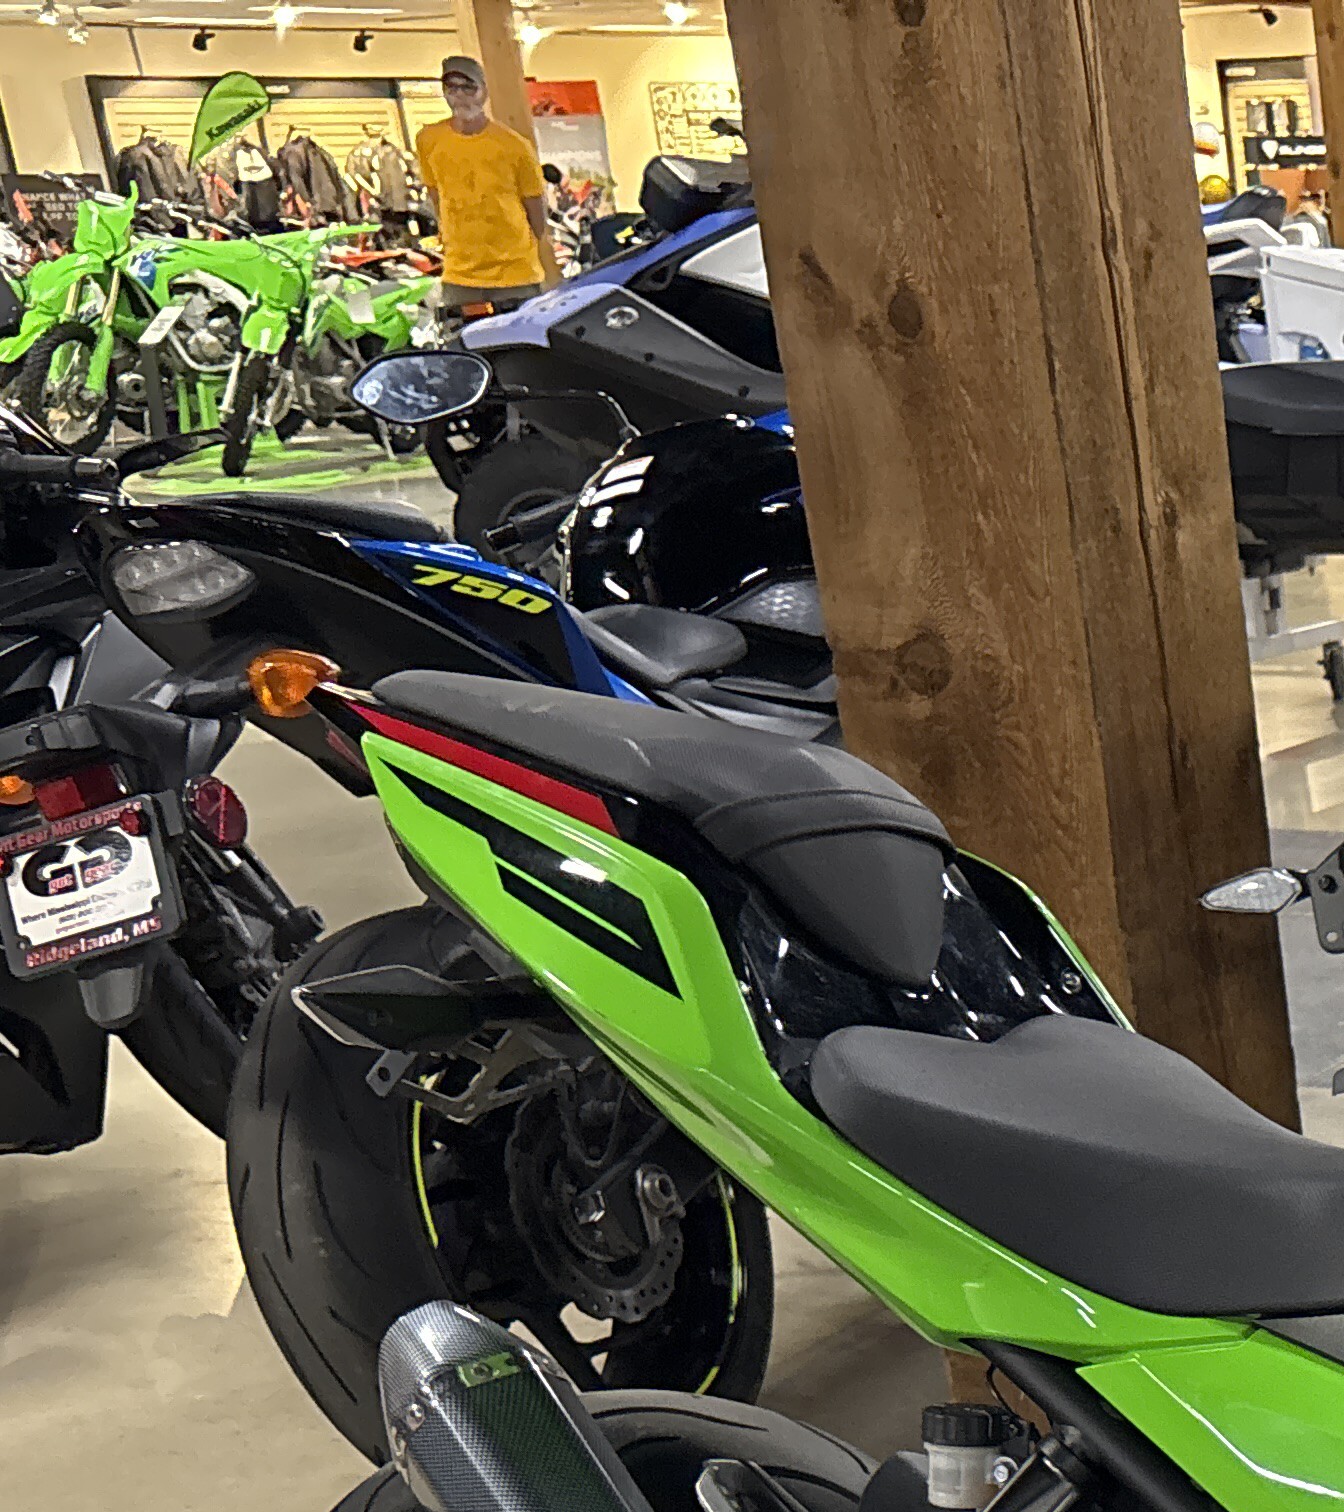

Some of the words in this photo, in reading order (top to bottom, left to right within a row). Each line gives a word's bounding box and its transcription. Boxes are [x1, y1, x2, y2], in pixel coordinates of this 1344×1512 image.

[205, 99, 261, 141] Kawasaki
[411, 563, 553, 615] 750
[26, 927, 130, 969] Ridgeland,
[133, 916, 162, 937] MS
